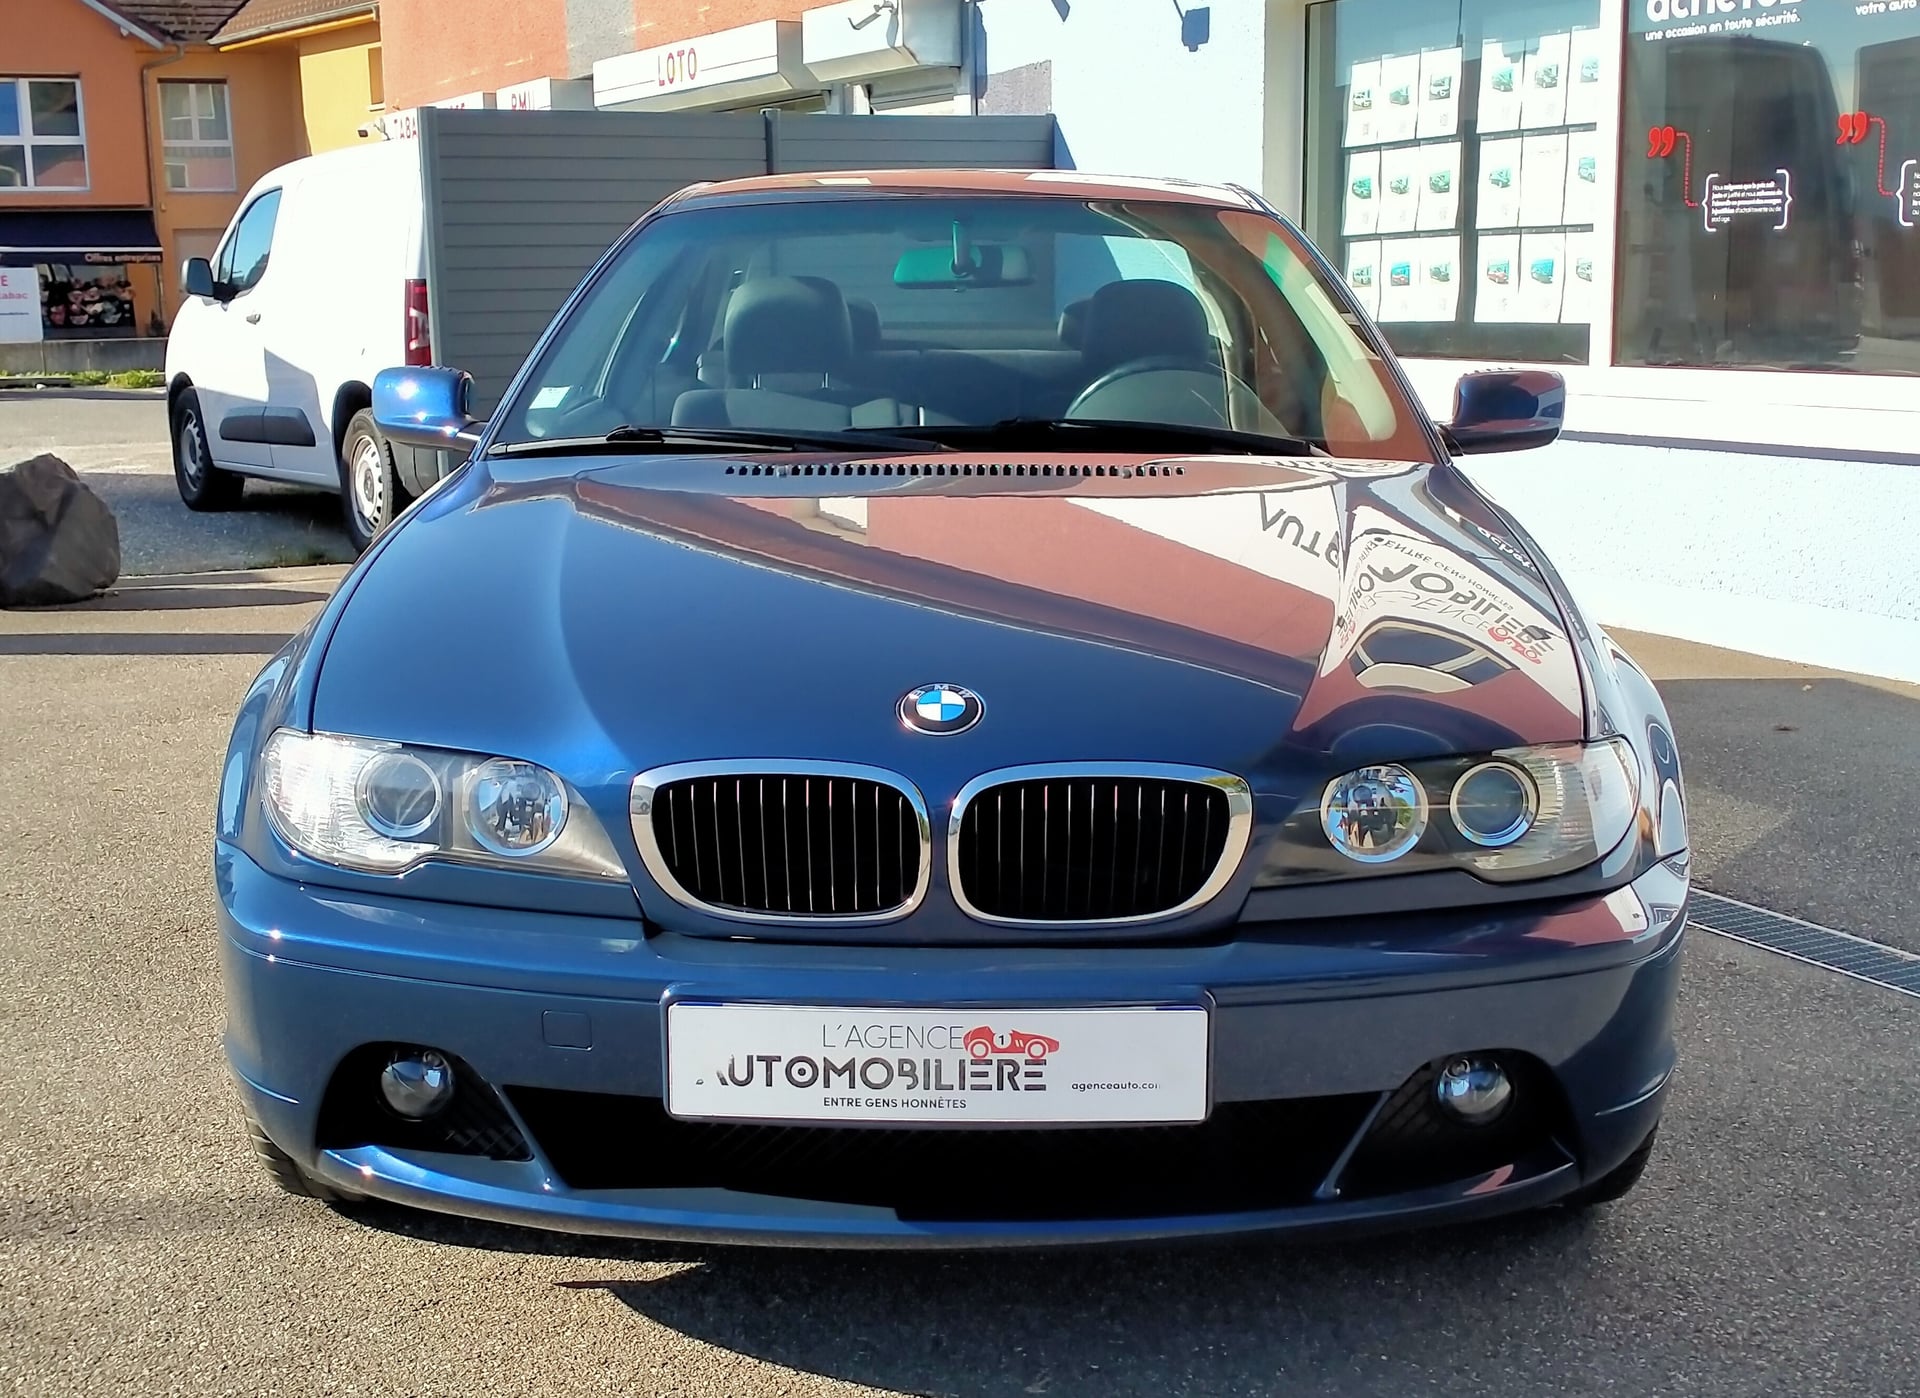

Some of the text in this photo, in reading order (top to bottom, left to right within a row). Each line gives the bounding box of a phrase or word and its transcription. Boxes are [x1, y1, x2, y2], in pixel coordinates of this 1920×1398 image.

[1855, 1, 1886, 15] votre
[1645, 31, 1664, 41] une
[1665, 23, 1707, 39] occasion
[1709, 22, 1722, 33] en
[1725, 17, 1752, 31] toute
[1755, 9, 1800, 27] sécurité.
[658, 47, 697, 86] LOTO
[908, 684, 974, 699] BMW
[998, 1035, 1005, 1046] 1
[823, 1095, 967, 1109] ENTRE GENS HONNÊTES
